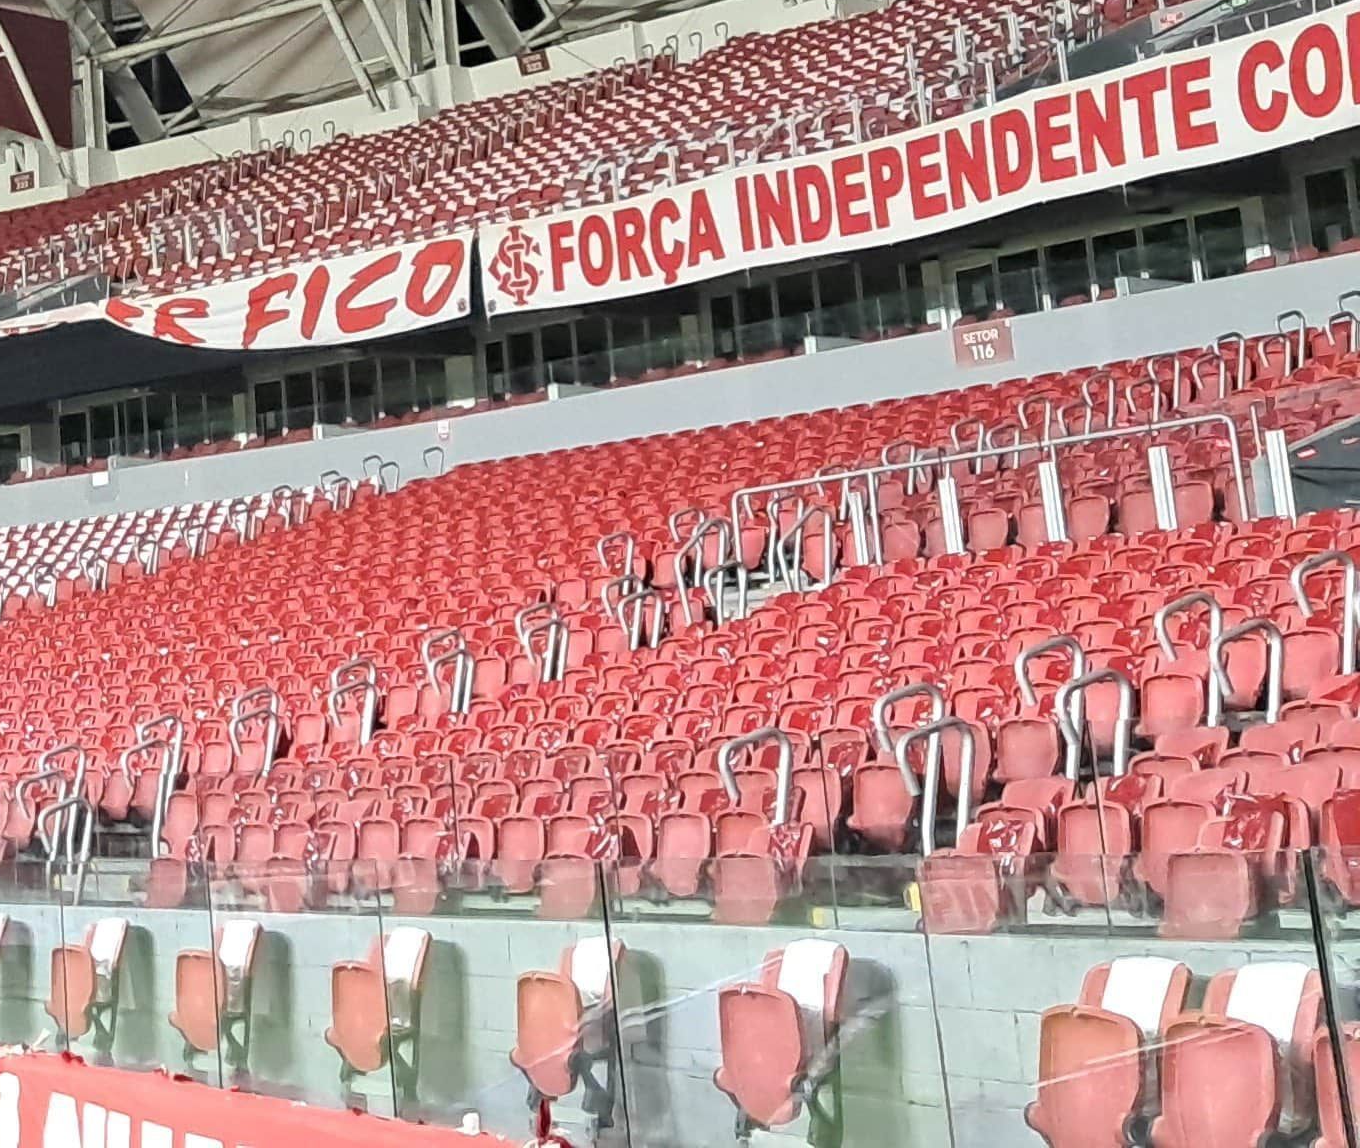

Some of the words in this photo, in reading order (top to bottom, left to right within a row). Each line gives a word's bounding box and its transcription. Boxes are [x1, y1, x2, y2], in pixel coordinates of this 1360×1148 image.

[547, 188, 726, 286] FORÇA
[734, 56, 1219, 253] INDEPENDENTE
[241, 238, 465, 349] FICO
[962, 328, 999, 346] SETOR
[971, 343, 995, 361] 116
